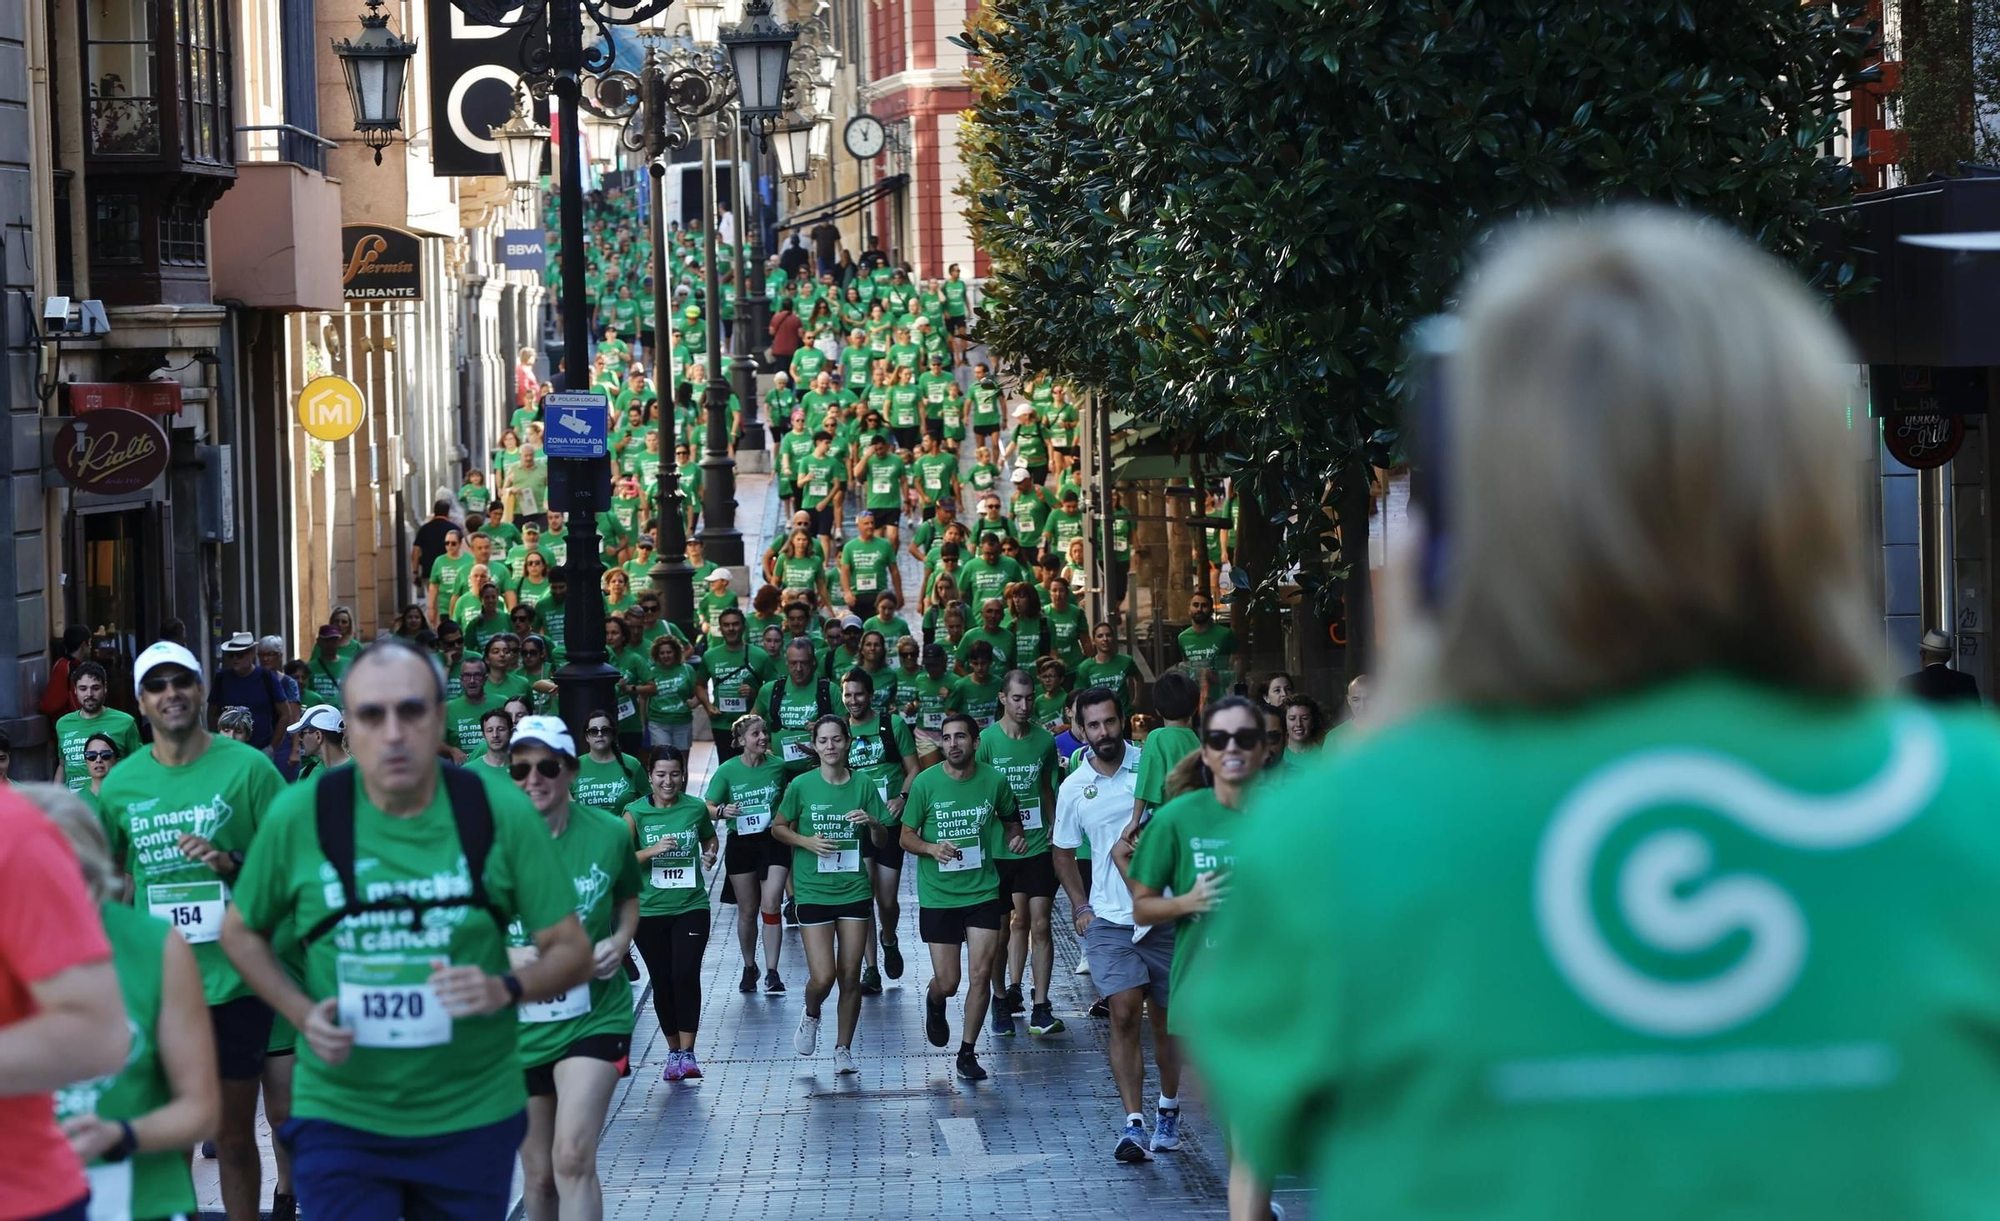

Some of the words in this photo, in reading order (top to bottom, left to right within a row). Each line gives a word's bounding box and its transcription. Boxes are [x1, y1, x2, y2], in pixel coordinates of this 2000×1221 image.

[507, 244, 543, 256] BBVA
[1908, 418, 1951, 458] grill
[67, 431, 156, 478] Rialto
[459, 724, 468, 732] En
[63, 738, 72, 746] En
[62, 745, 85, 754] contra
[1008, 763, 1040, 773] marcha
[590, 782, 623, 791] marcha
[578, 790, 605, 798] contra
[732, 791, 744, 800] En
[587, 796, 618, 805] cáncer
[811, 812, 825, 821] En
[935, 810, 950, 820] En
[951, 806, 988, 818] marcha
[131, 817, 150, 834] En
[153, 806, 216, 828] marcha
[746, 815, 760, 826] 151
[812, 821, 842, 831] contra
[937, 818, 968, 829] contra
[646, 833, 660, 843] En
[937, 829, 947, 838] el
[948, 826, 980, 837] cáncer
[133, 829, 184, 849] contra
[138, 852, 152, 865] el
[836, 852, 842, 863] 7
[1193, 852, 1217, 869] En
[663, 868, 684, 880] 1112
[323, 881, 347, 909] E
[170, 905, 203, 927] 154
[508, 920, 524, 936] el
[360, 926, 453, 951] cáncer
[361, 992, 425, 1020] 1320
